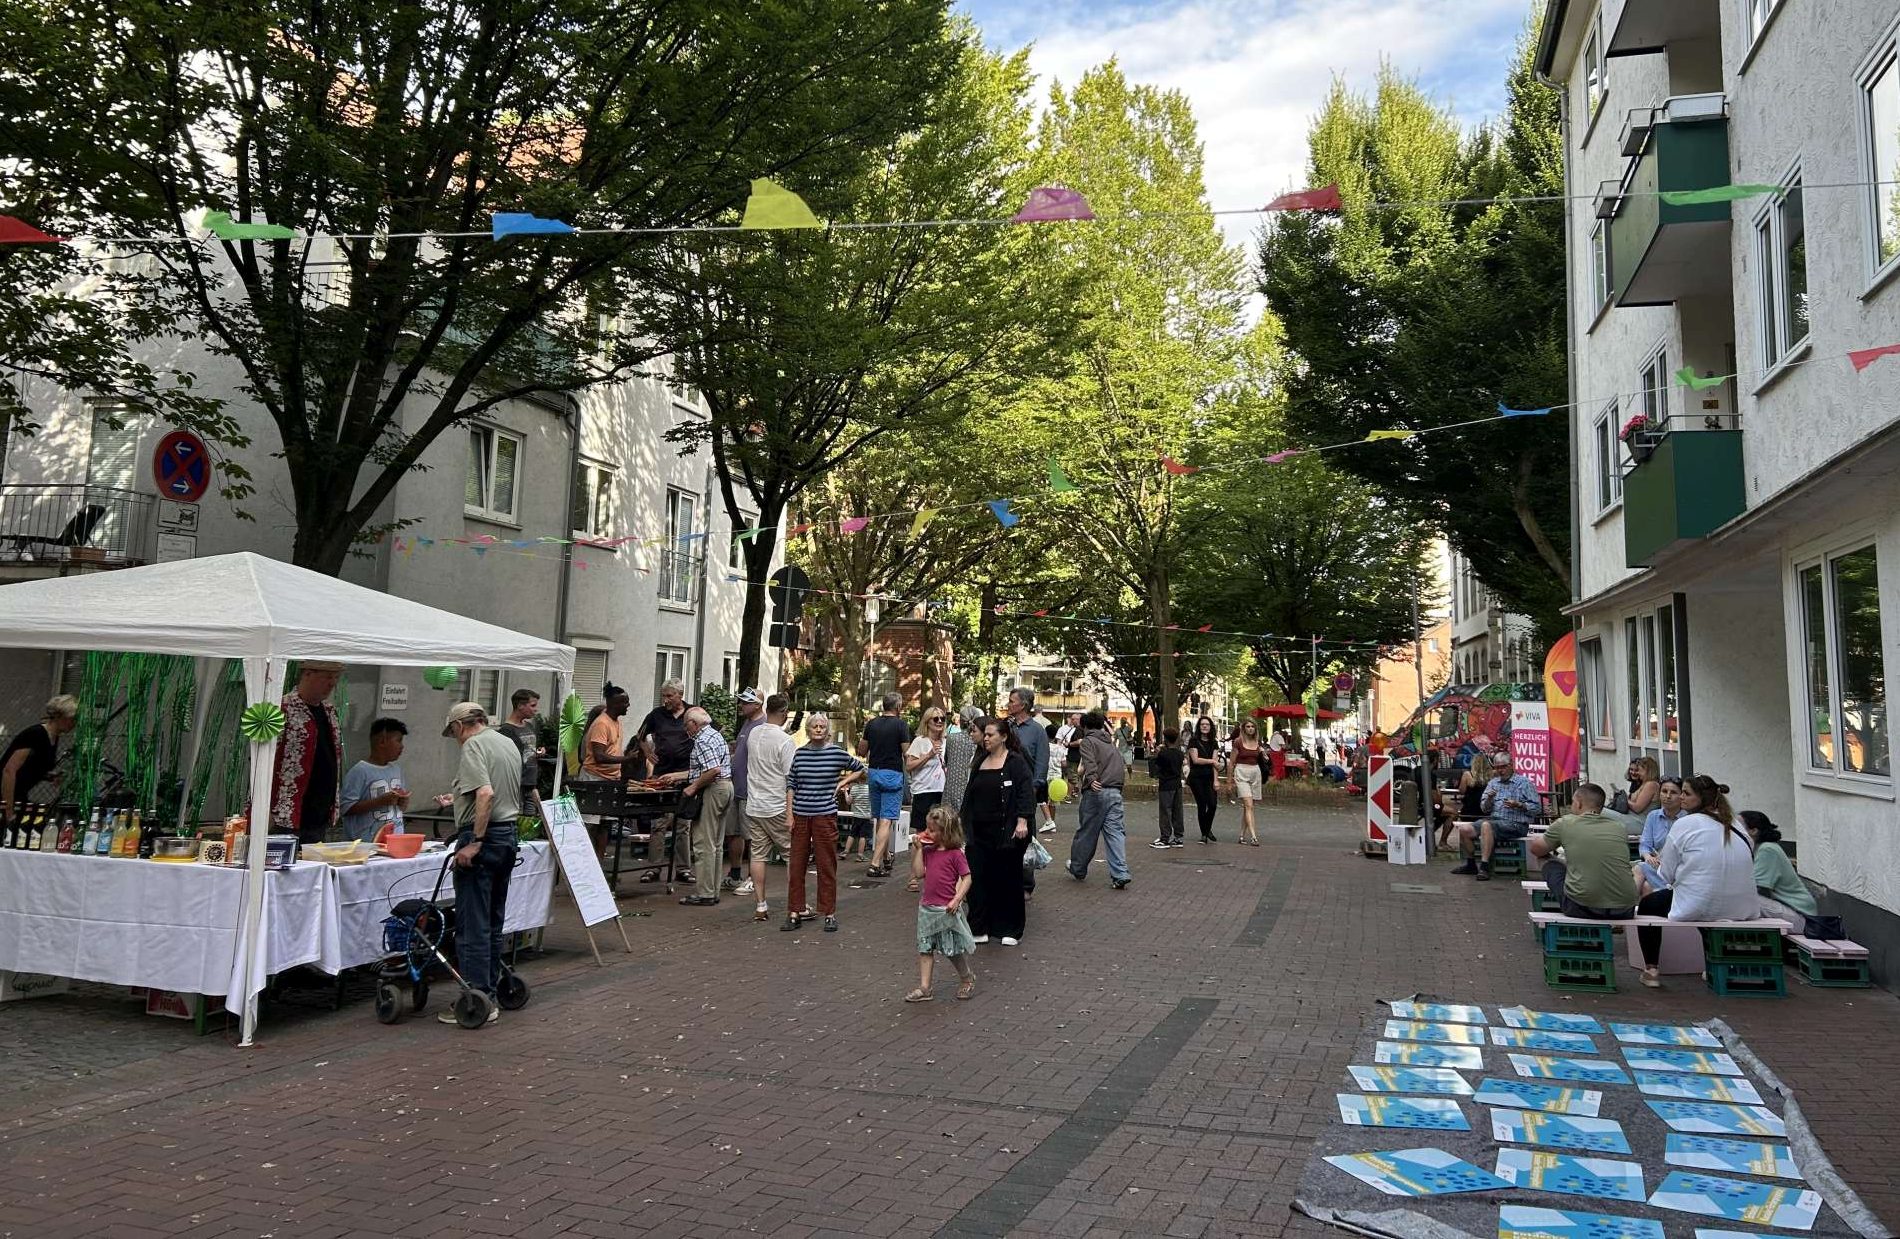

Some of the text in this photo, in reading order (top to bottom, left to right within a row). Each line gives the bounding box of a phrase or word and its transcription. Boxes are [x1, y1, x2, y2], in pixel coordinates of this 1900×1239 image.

[1525, 712, 1541, 721] VIVA
[1514, 733, 1547, 741] HERZLICH
[1515, 742, 1547, 757] WILL
[1515, 757, 1546, 772] KOM
[1522, 773, 1546, 787] EN
